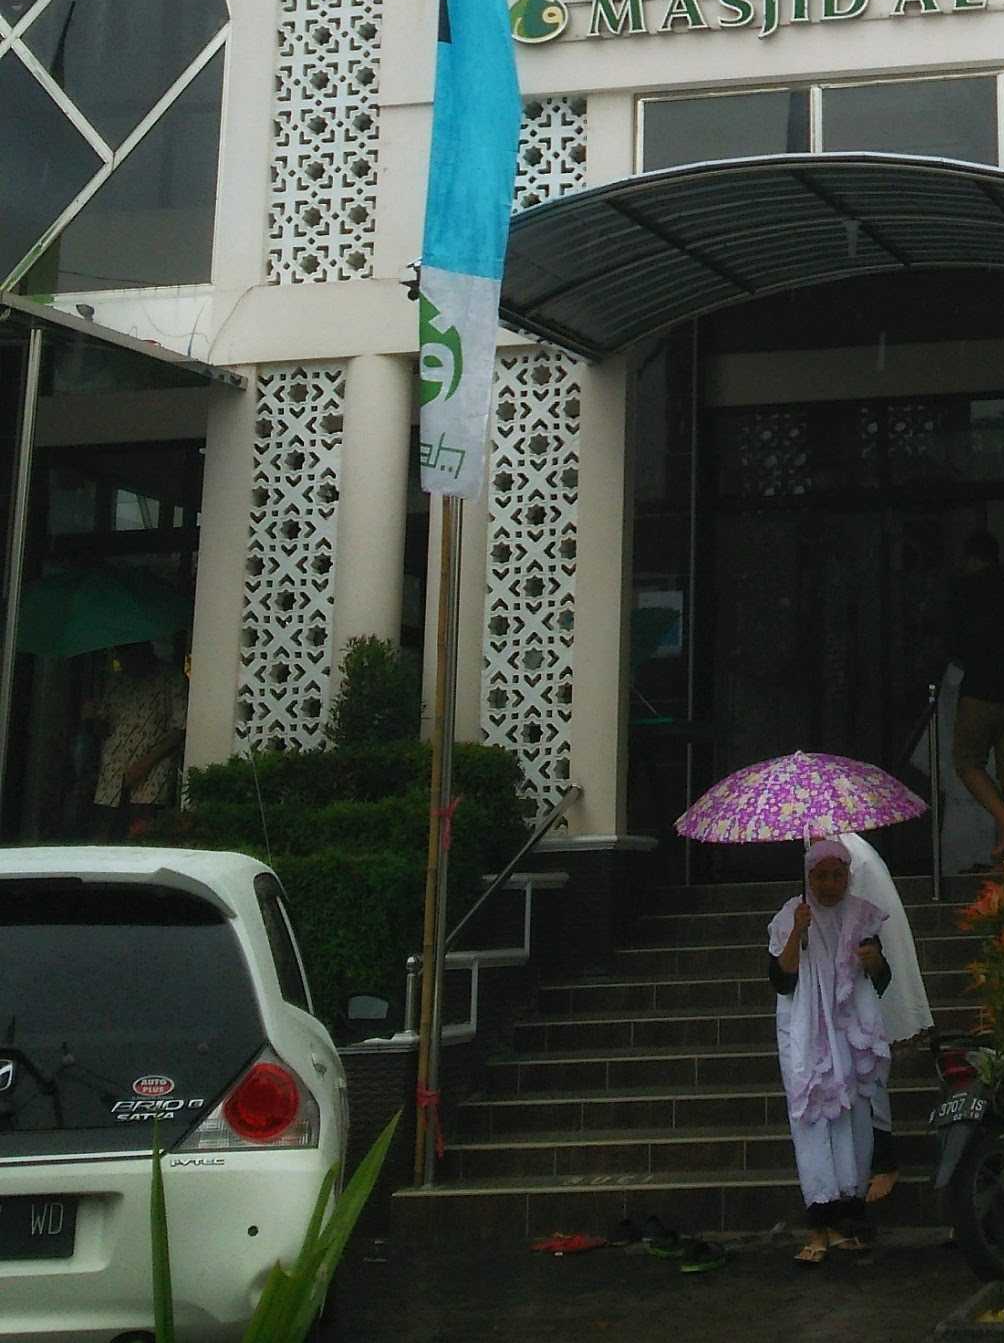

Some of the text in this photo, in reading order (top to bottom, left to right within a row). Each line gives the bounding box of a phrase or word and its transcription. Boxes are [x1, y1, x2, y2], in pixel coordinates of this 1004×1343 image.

[140, 1078, 168, 1086] AUTO
[111, 1099, 185, 1113] BRIO
[31, 1202, 64, 1235] WD
